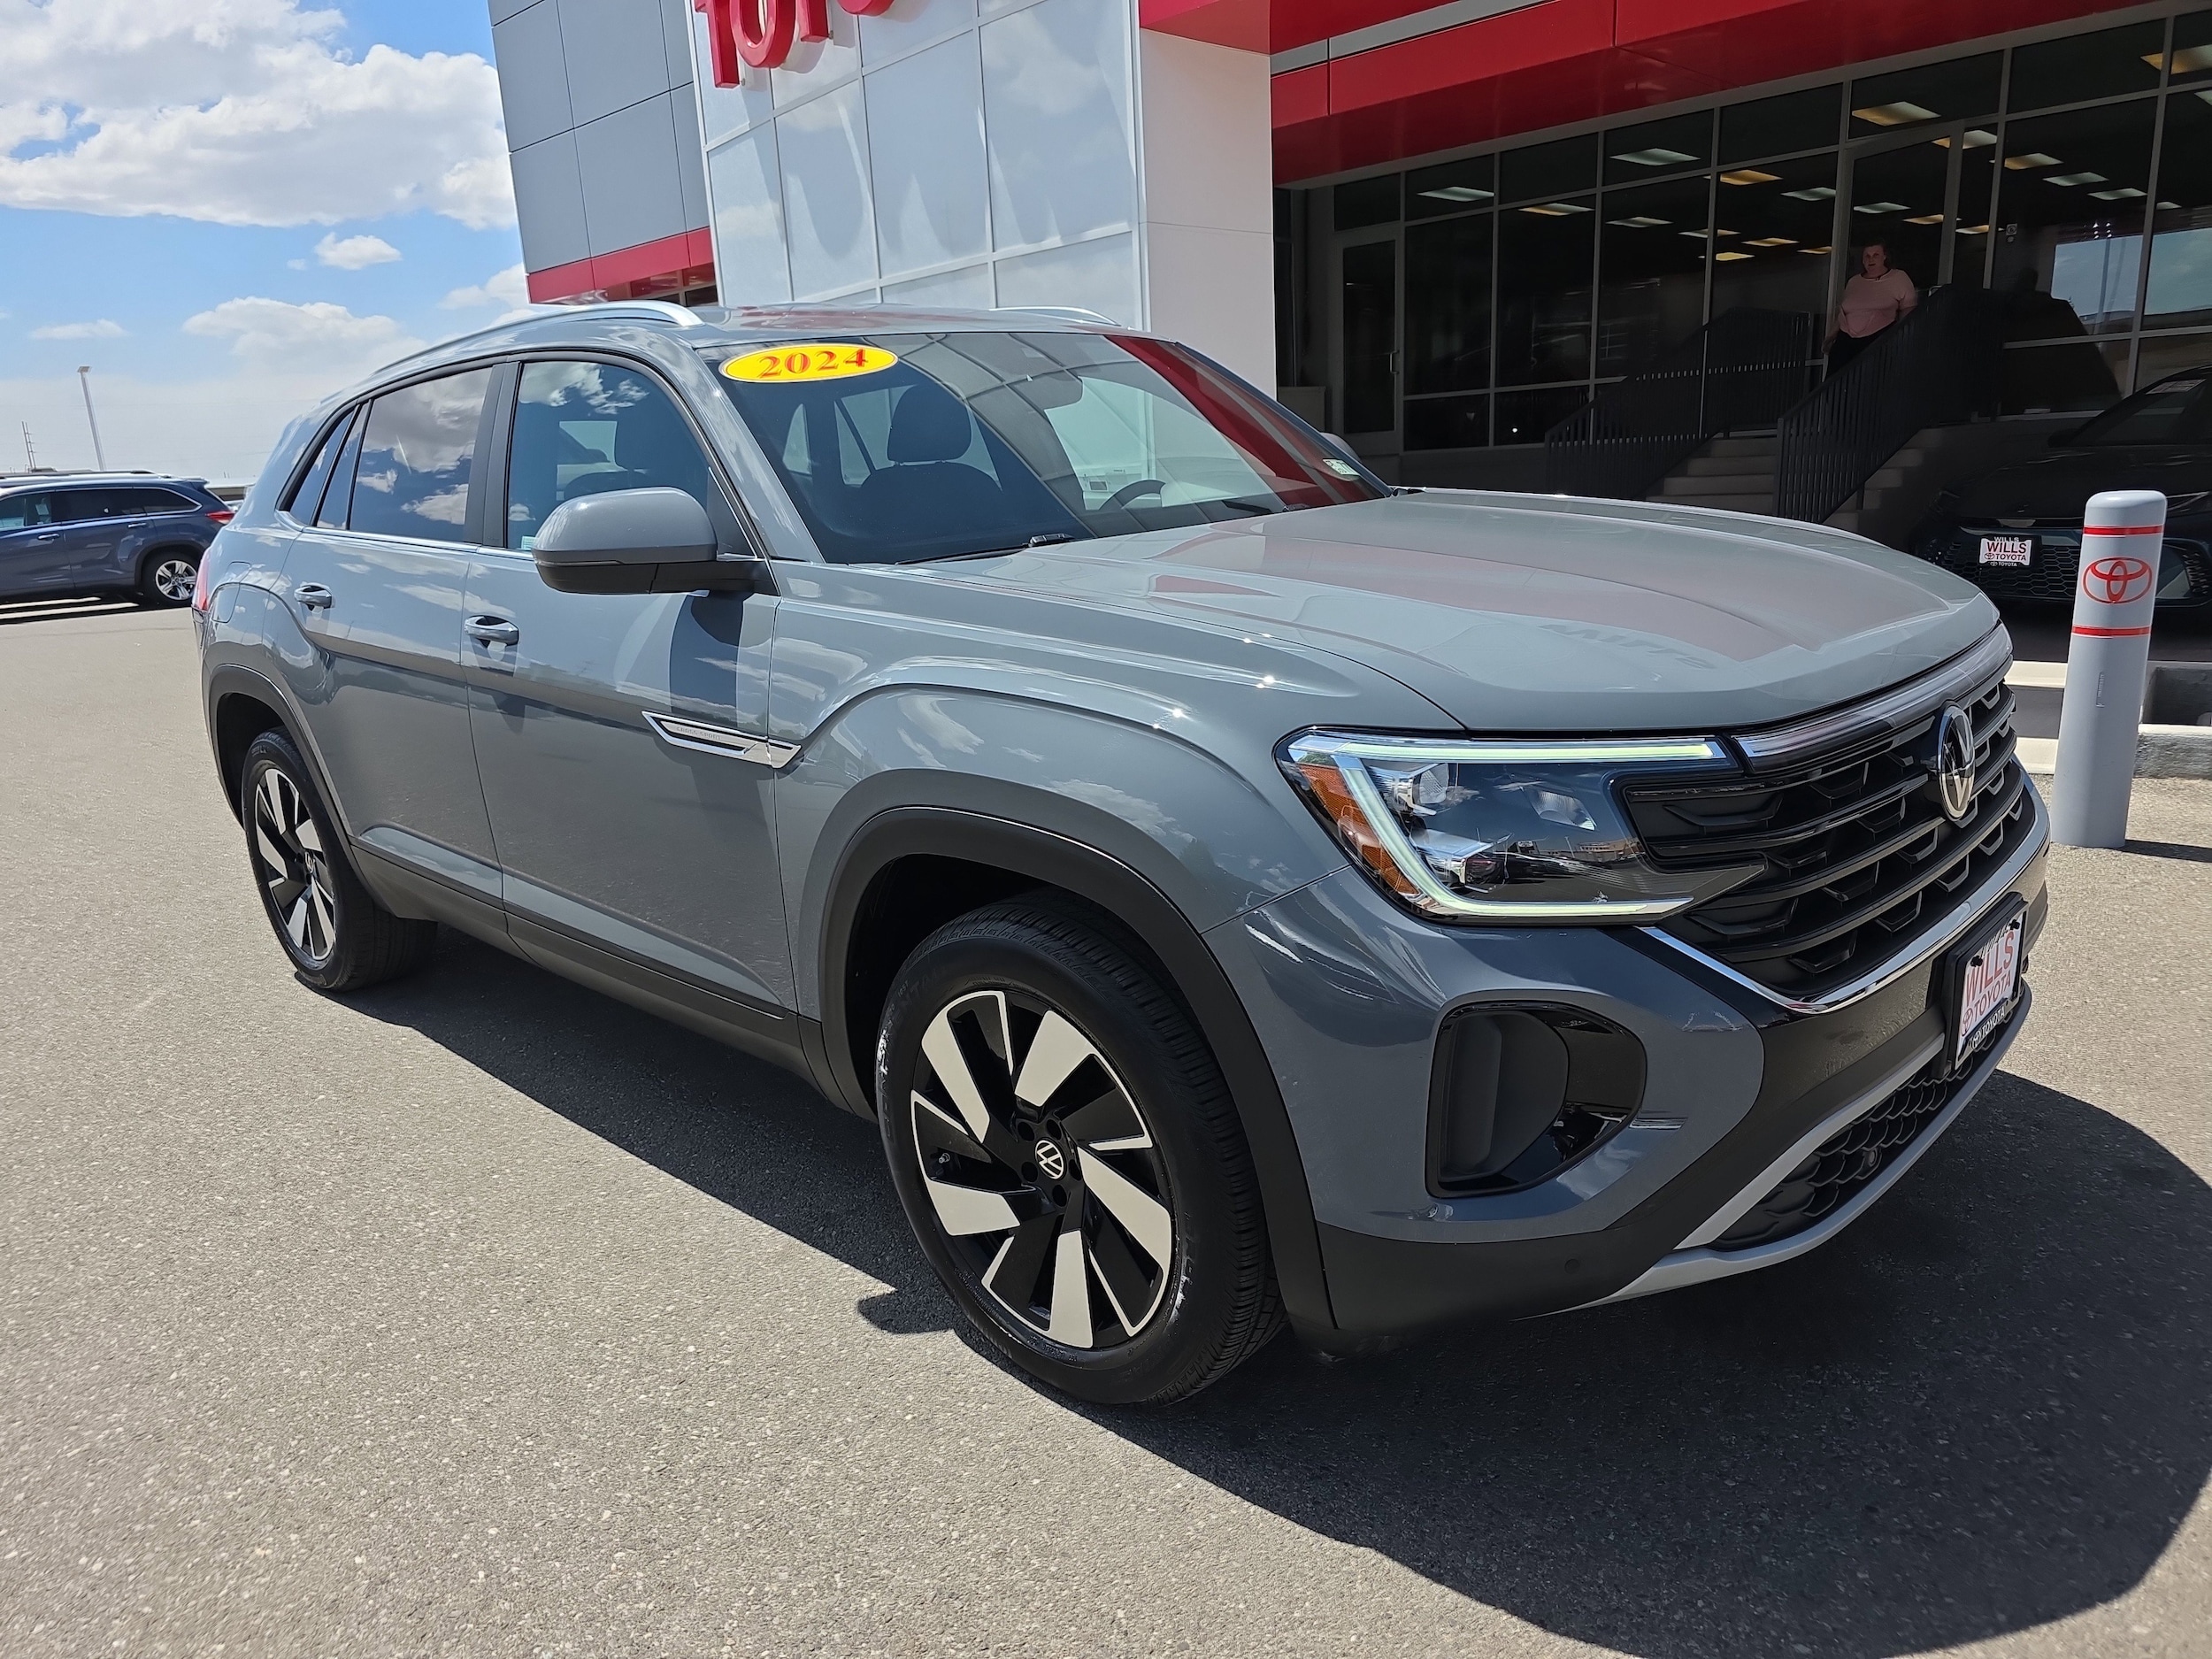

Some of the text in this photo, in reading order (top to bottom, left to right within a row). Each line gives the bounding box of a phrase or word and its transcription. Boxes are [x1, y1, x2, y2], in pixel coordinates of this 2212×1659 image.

[757, 348, 869, 379] 2024
[1987, 541, 2027, 554] WILLS
[1966, 931, 2015, 1008] WILLS
[1974, 970, 2011, 1023] TOYOTA
[1982, 1005, 2006, 1039] TOYOTA
